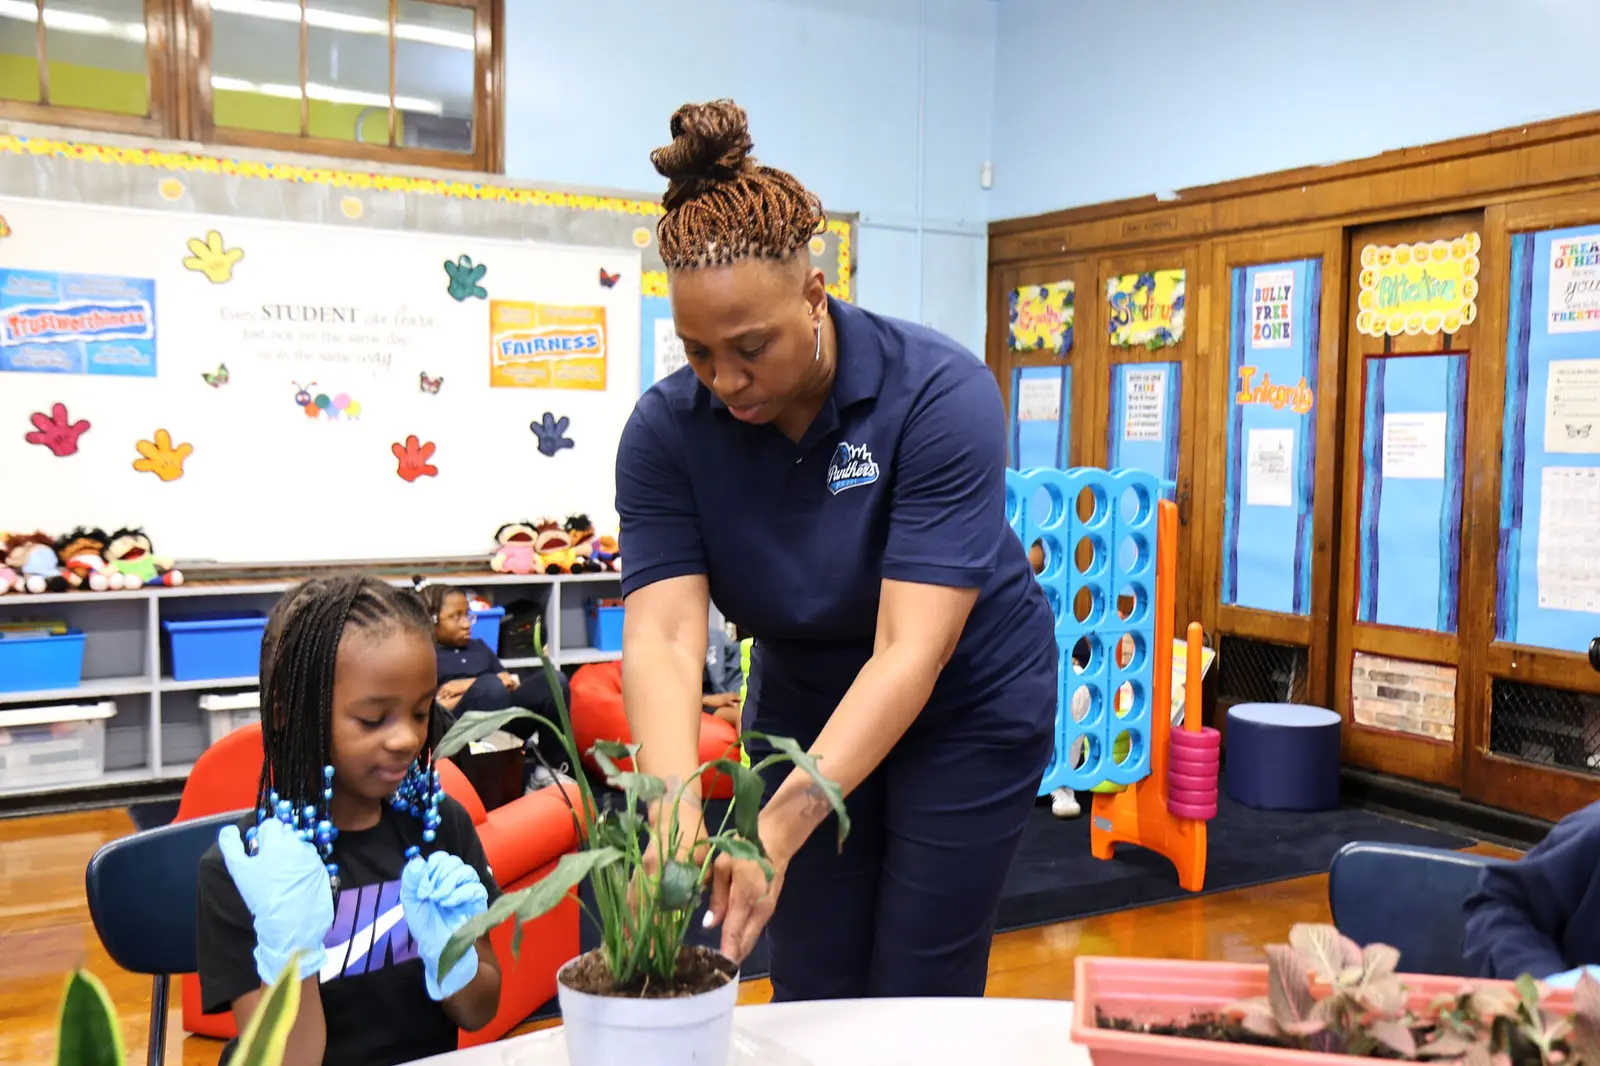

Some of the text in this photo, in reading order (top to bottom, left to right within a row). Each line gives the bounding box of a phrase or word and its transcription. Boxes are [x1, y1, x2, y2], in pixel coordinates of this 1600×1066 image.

[1254, 285, 1291, 302] BULLY
[1564, 280, 1600, 304] you
[261, 304, 360, 324] STUDENT
[1255, 304, 1289, 320] FREE
[8, 309, 145, 337] Trustworthiness
[1253, 322, 1290, 340] ZONE
[502, 335, 598, 356] FAIRNESS
[827, 461, 876, 483] Panthers
